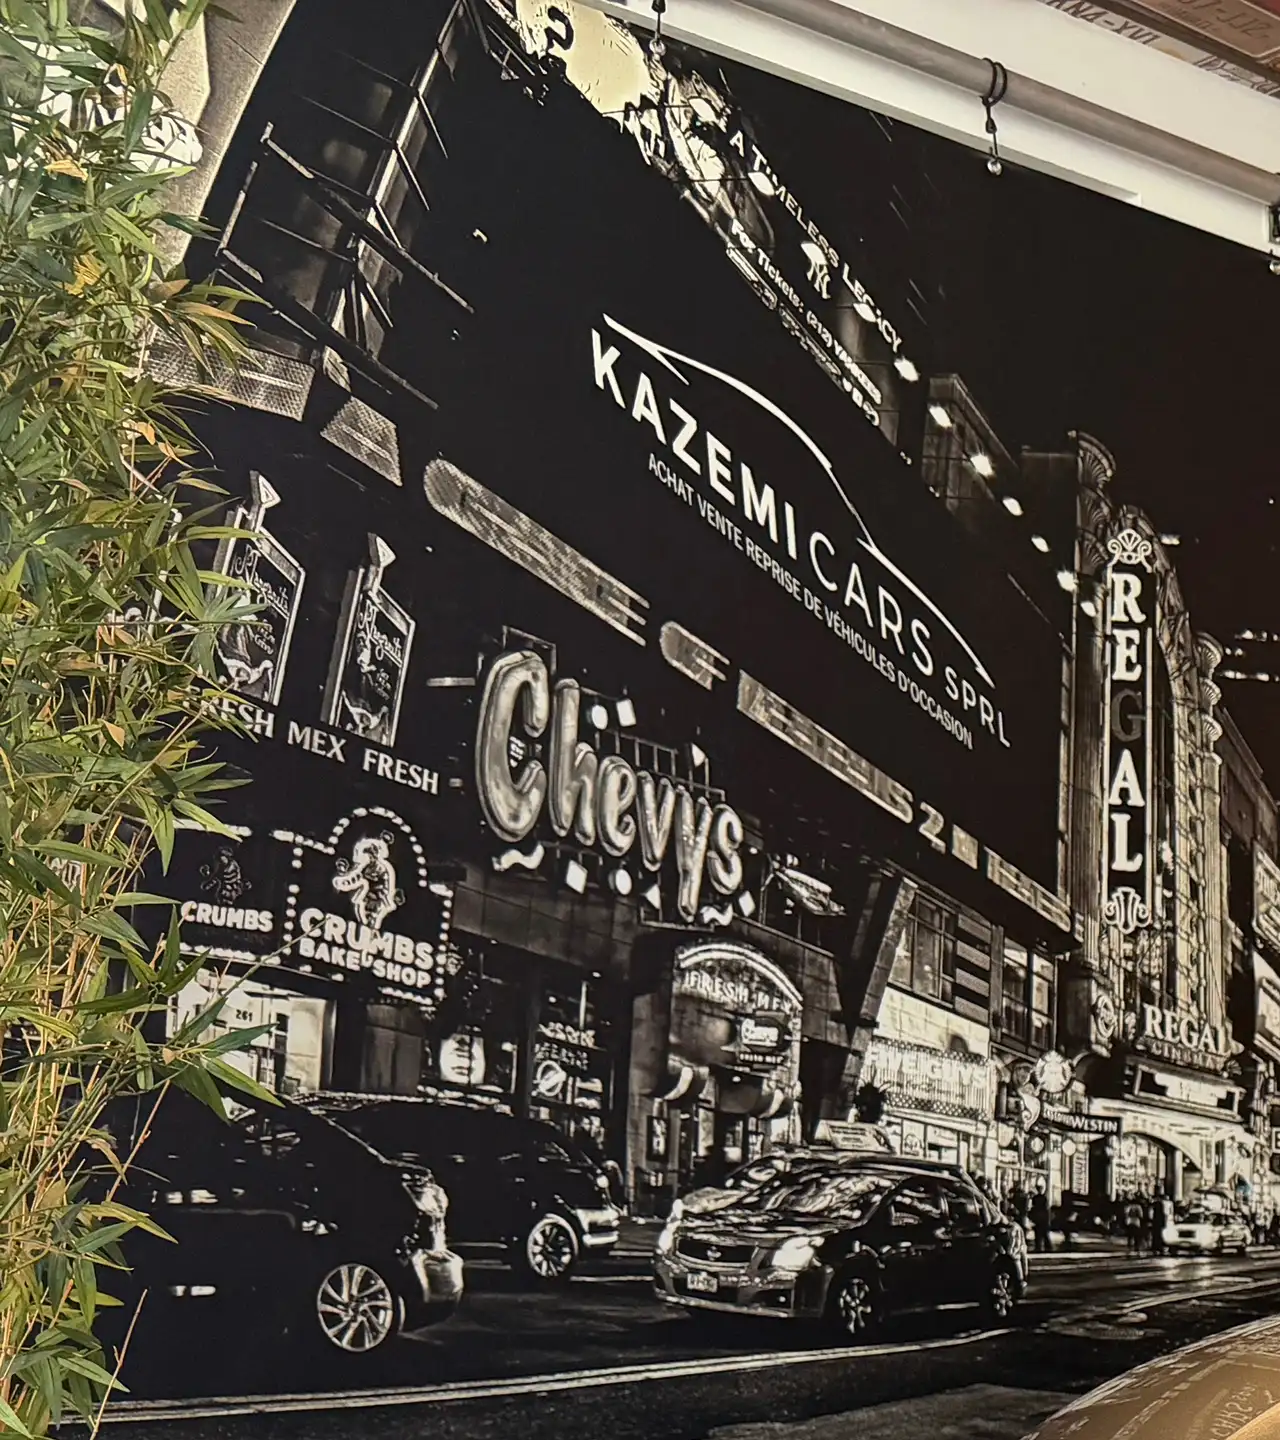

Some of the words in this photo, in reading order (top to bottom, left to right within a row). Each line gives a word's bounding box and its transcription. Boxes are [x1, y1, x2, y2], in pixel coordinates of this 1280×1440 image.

[591, 327, 797, 561] KAZEMI
[809, 531, 934, 677] CARS
[944, 666, 1011, 748] SPRL
[648, 453, 695, 507] ACHAT
[696, 493, 744, 551] VENTE
[745, 536, 803, 603] REPRISE
[803, 588, 824, 621] DE
[824, 607, 896, 684] VÉHICULES
[897, 669, 974, 750] D'OCCASION
[287, 721, 346, 763] MEX
[362, 748, 439, 796] FRESH
[475, 650, 743, 922] Chevys
[1109, 572, 1147, 873] REGAL
[180, 900, 274, 933] CRUMBS
[300, 907, 435, 971] CRUMBS
[372, 960, 432, 989] SHOP
